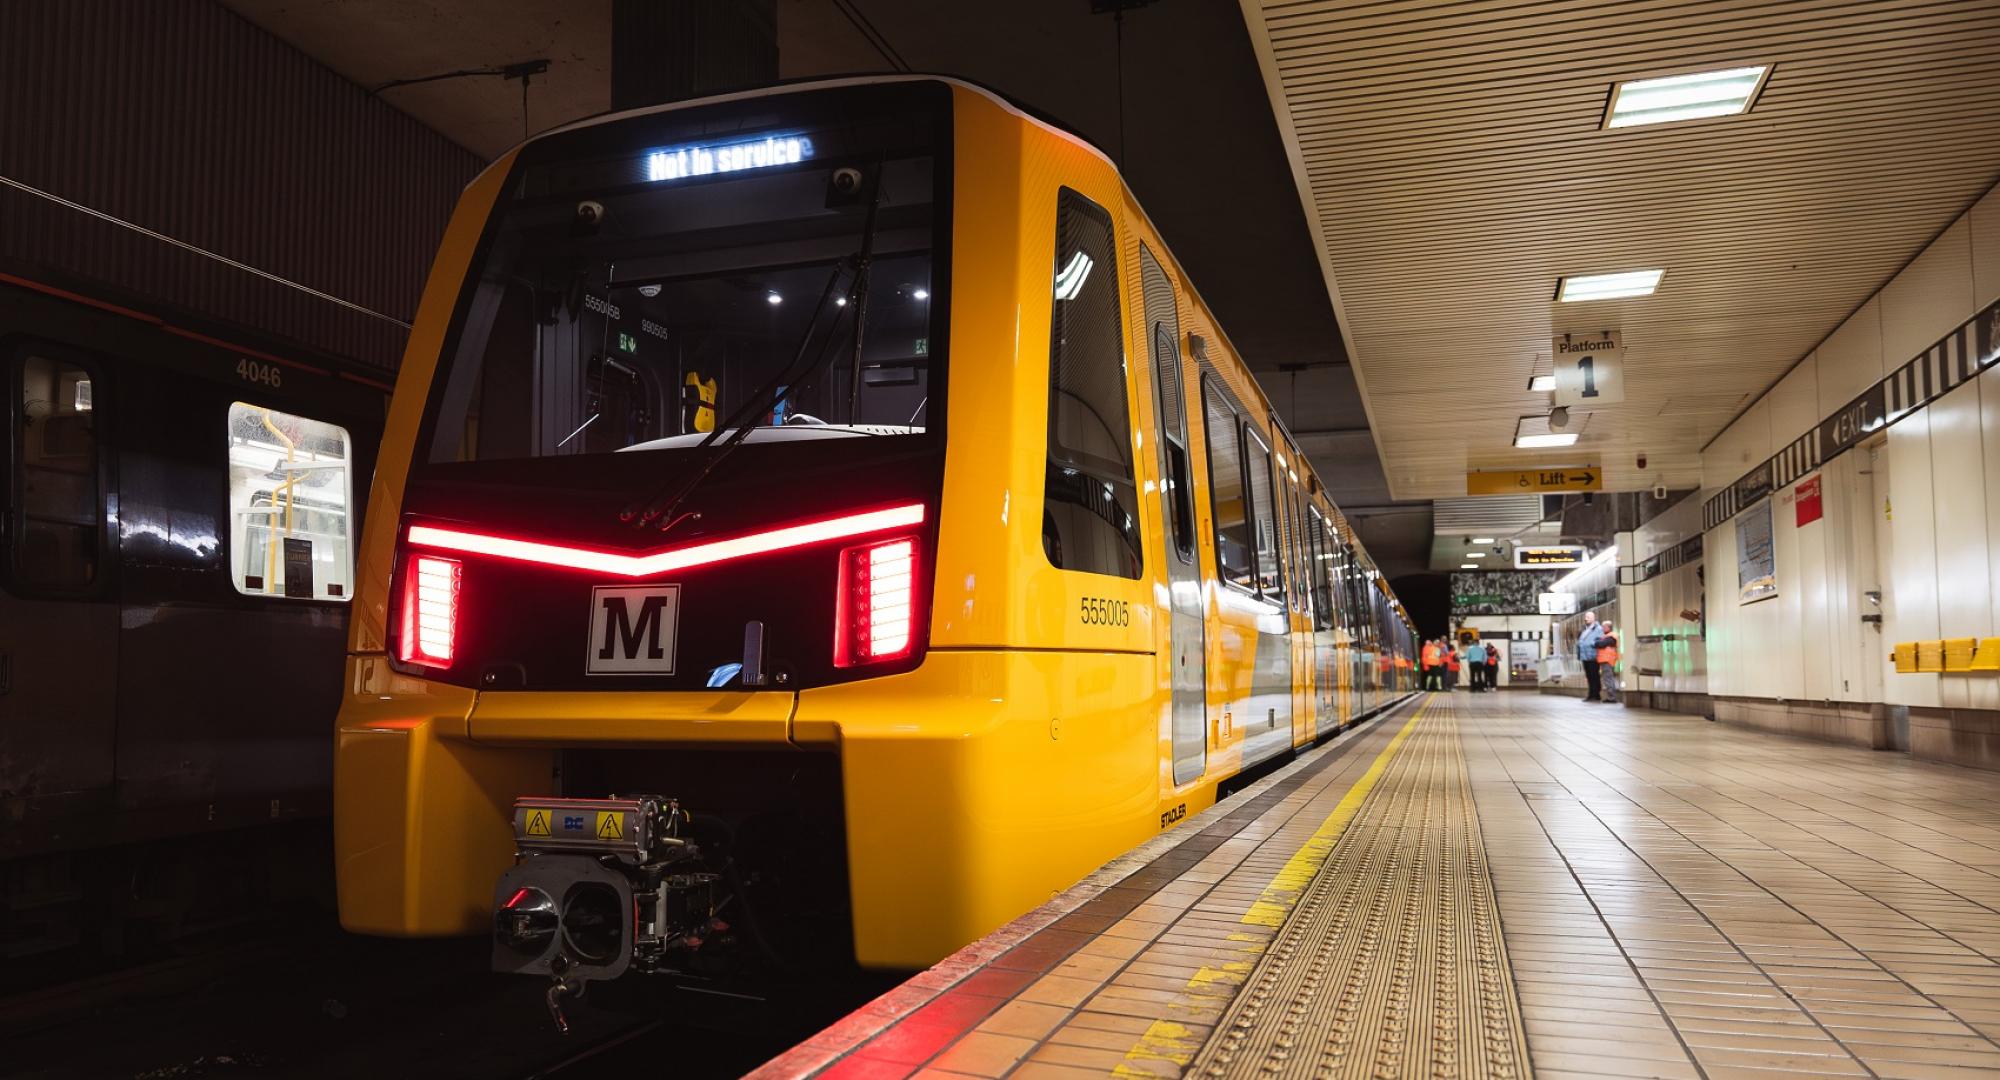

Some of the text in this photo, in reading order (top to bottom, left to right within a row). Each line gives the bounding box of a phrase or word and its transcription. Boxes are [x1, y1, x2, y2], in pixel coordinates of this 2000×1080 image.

[650, 151, 687, 181] Not
[718, 138, 802, 172] service
[1559, 340, 1615, 353] Platform
[236, 359, 281, 388] 4046
[1577, 355, 1599, 398] 1
[1841, 401, 1868, 442] EXIT
[1540, 472, 1566, 486] Lift
[598, 595, 668, 660] M
[1080, 596, 1129, 628] 555005
[1160, 803, 1187, 829] STADLER
